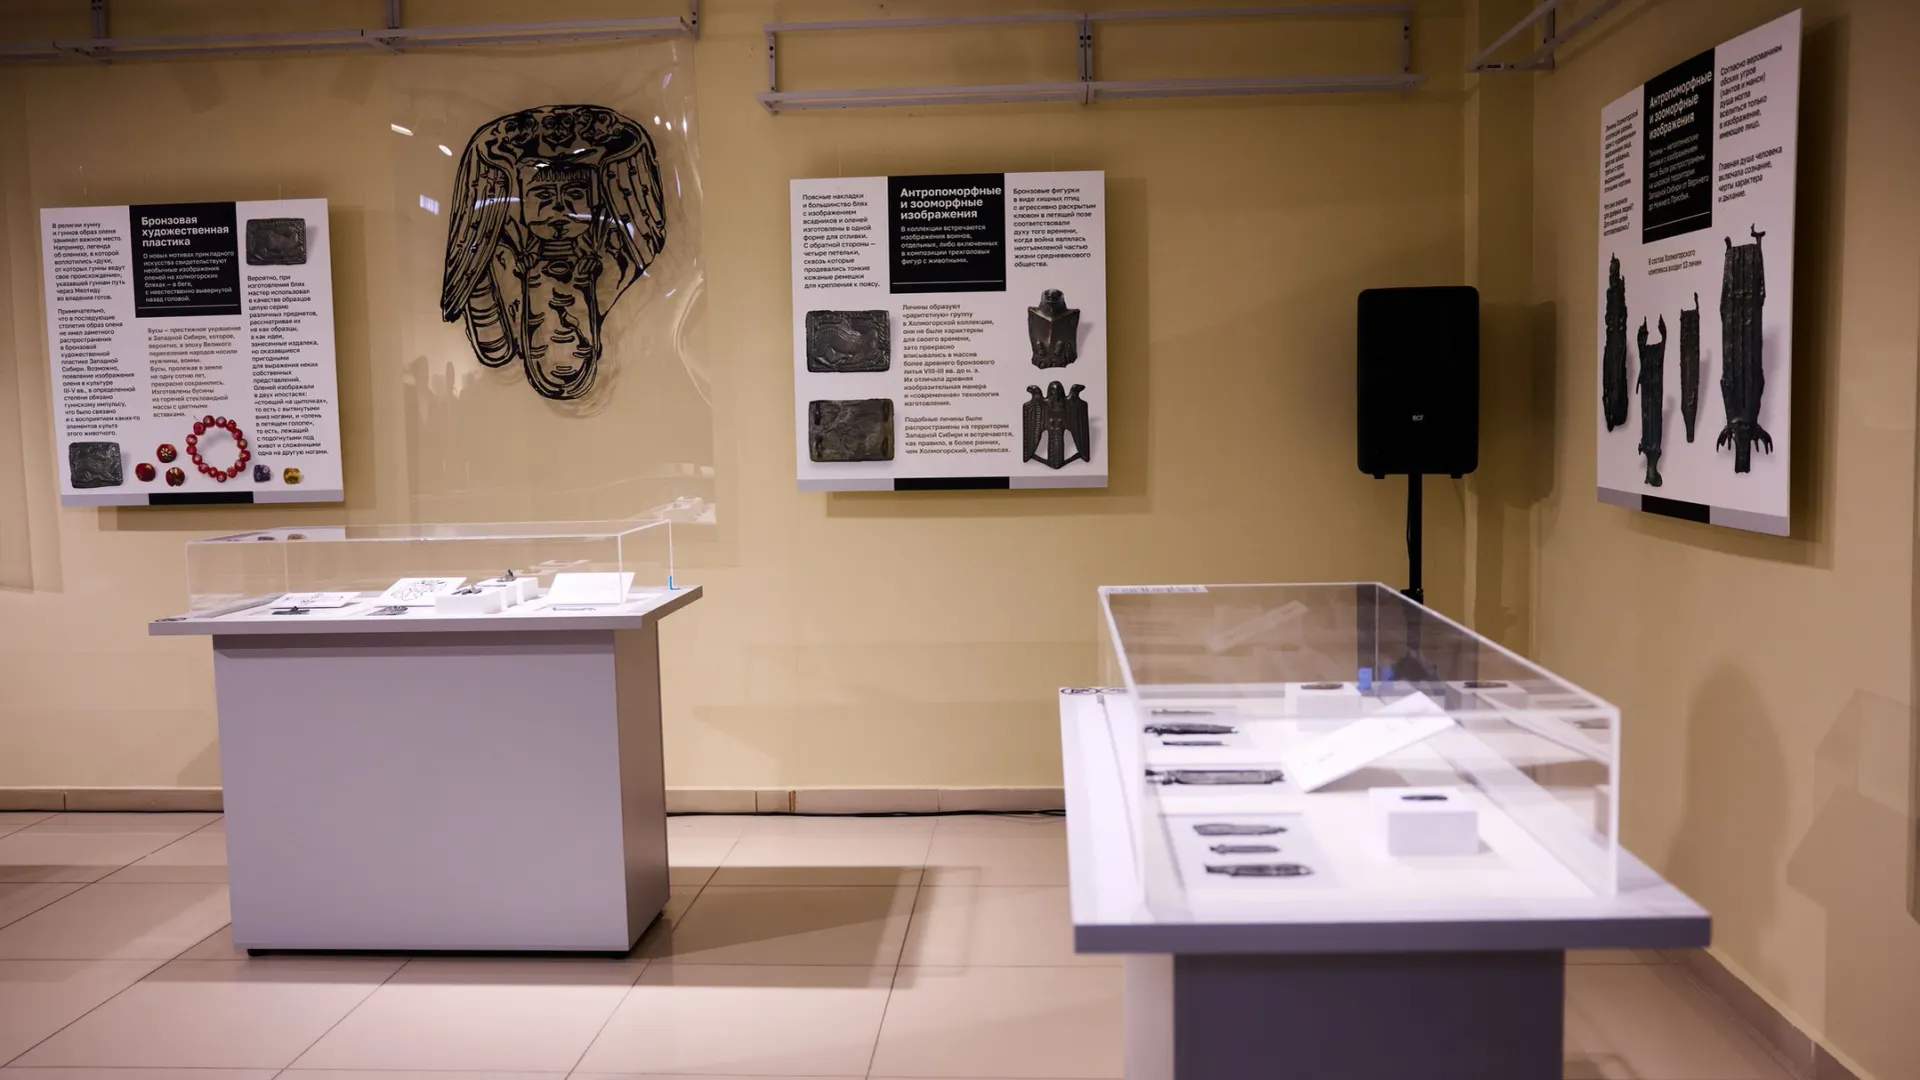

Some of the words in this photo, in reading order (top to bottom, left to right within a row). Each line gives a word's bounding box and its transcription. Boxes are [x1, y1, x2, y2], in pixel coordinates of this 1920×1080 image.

[1720, 59, 1746, 76] Согласно
[1746, 44, 1782, 66] верованиям
[1720, 73, 1739, 87] обских
[1740, 66, 1756, 81] угров
[1650, 71, 1712, 109] Антропоморфные
[1720, 97, 1734, 109] душа
[1734, 90, 1751, 102] могла
[1649, 114, 1654, 124] и
[1654, 94, 1699, 122] зооморфные
[1720, 102, 1747, 119] вселиться
[1748, 95, 1767, 108] только
[1649, 112, 1694, 140] изображения
[1719, 125, 1744, 139] имеющее
[1718, 159, 1740, 171] Главная
[1739, 154, 1755, 166] душа
[1755, 146, 1783, 160] человека
[1718, 168, 1744, 182] включала
[1718, 182, 1734, 193] черты
[1735, 174, 1763, 188] характера
[900, 186, 1002, 199] Антропоморфные
[910, 198, 983, 210] зооморфные
[141, 216, 198, 227] Бронзовая
[900, 210, 978, 221] изображения
[142, 226, 229, 238] художественная
[142, 238, 191, 247] пластика
